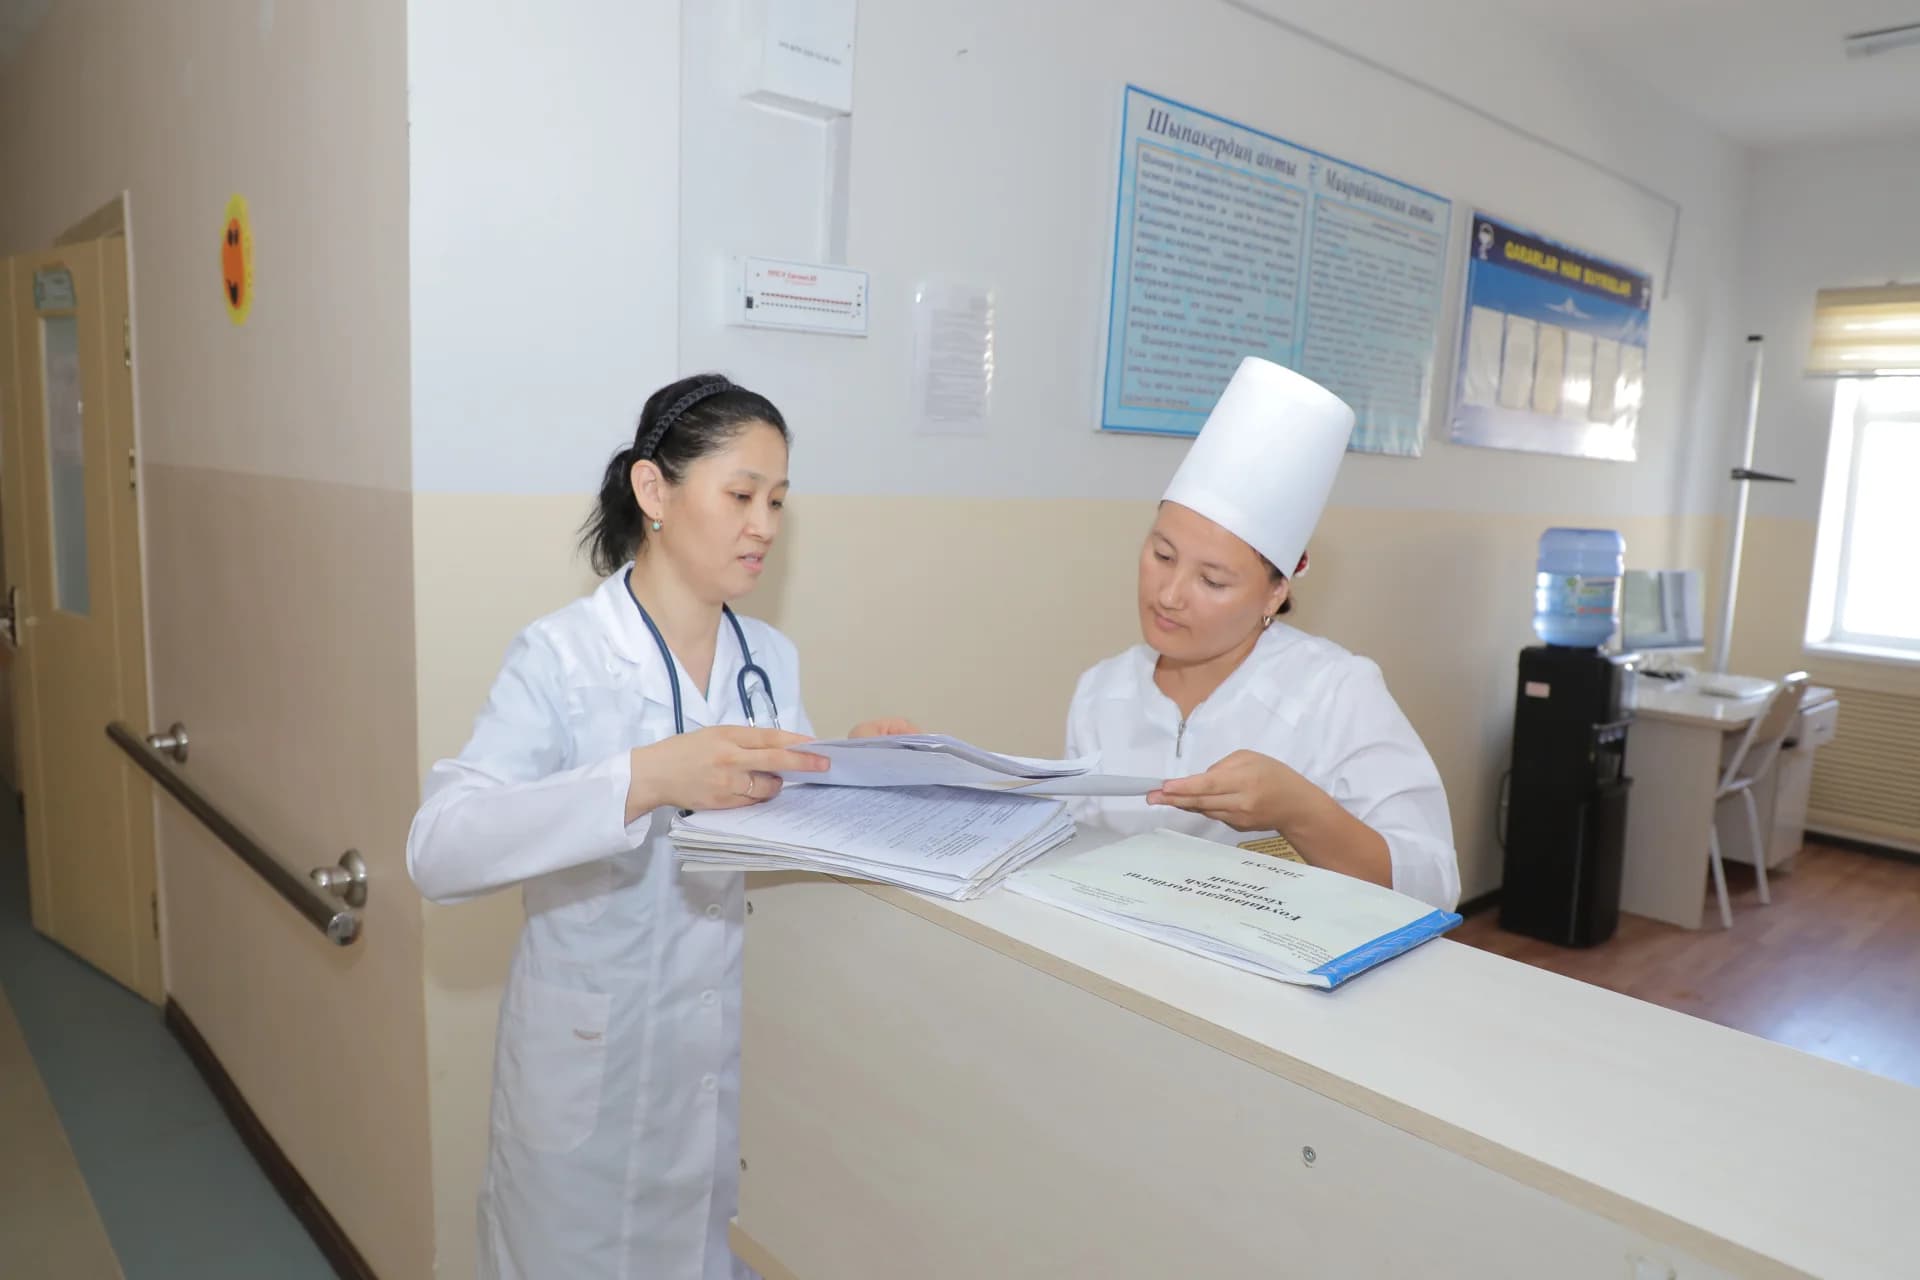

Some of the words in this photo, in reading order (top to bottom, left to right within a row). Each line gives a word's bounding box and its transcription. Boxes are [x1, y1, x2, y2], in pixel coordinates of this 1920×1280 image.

[1123, 871, 1193, 893] dorilarni
[1184, 877, 1222, 891] olish
[1197, 890, 1302, 922] Foydalangan
